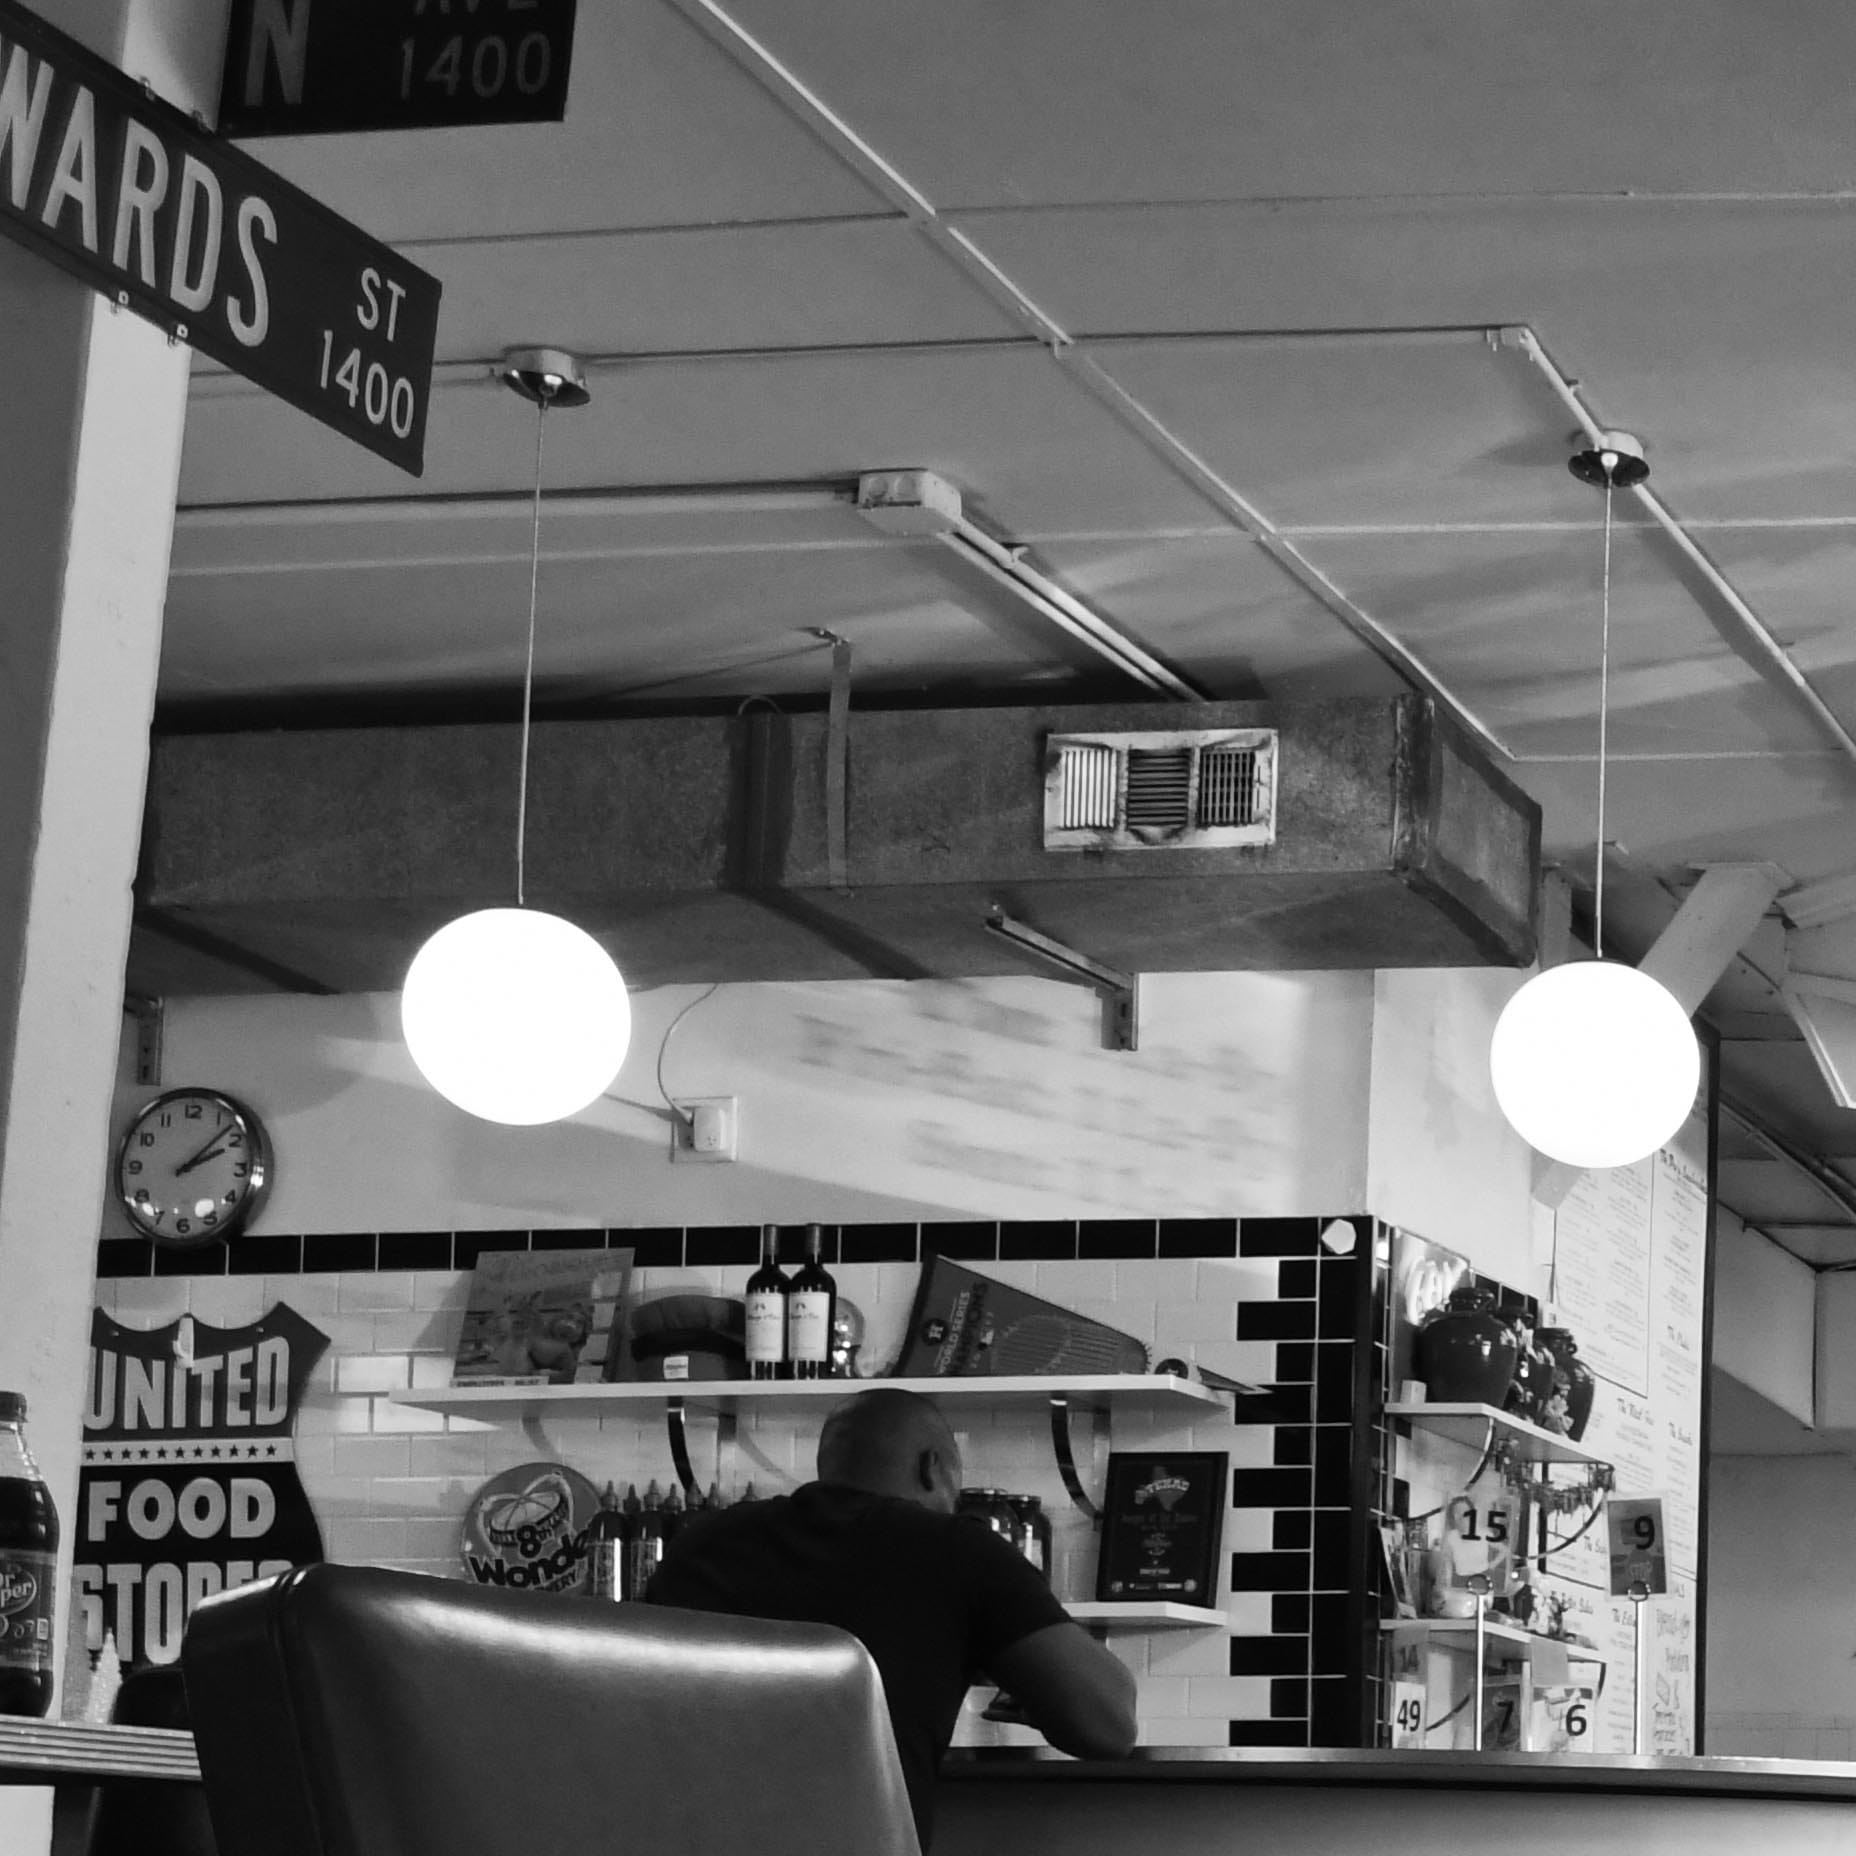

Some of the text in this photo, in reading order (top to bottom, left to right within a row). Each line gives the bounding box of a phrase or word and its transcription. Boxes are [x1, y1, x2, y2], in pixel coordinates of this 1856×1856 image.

[400, 31, 550, 100] 1400
[356, 267, 407, 342] ST
[318, 329, 415, 440] 1400
[185, 1104, 203, 1119] 12
[160, 1113, 172, 1128] 11
[139, 1132, 155, 1147] 10
[229, 1134, 242, 1148] 2
[128, 1160, 143, 1175] 9
[233, 1163, 246, 1178] 3
[224, 1189, 237, 1204] 4
[154, 1210, 165, 1226] 7
[176, 1218, 190, 1233] 6
[203, 1210, 218, 1226] 5
[84, 1336, 290, 1430] UNITED
[88, 1477, 277, 1541] FOOD
[1461, 1509, 1508, 1544] 15
[1634, 1515, 1656, 1550] 9
[1397, 1699, 1421, 1732] 49
[1566, 1700, 1588, 1737] 6
